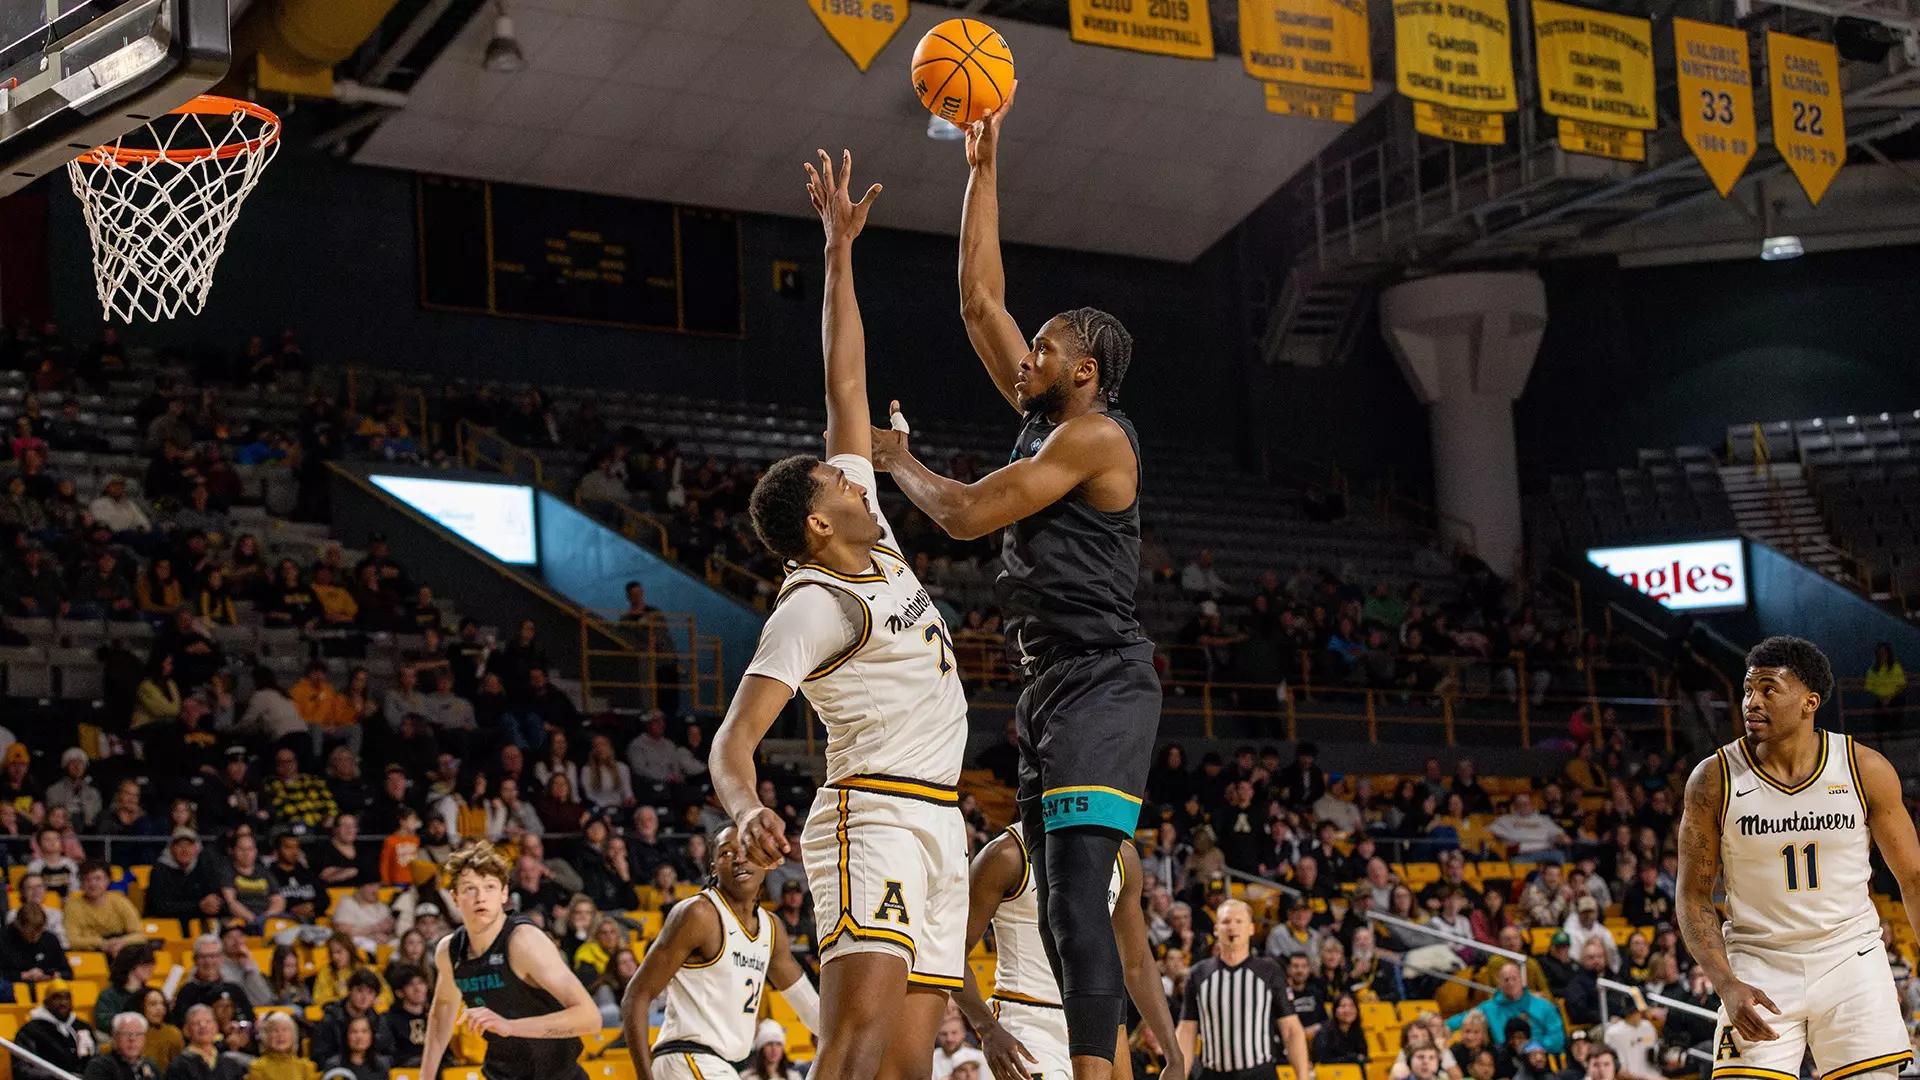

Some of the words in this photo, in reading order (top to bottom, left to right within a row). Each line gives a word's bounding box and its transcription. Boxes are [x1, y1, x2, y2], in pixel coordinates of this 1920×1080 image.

[1147, 0, 1189, 22] 2019
[1701, 89, 1734, 125] 33
[1793, 101, 1824, 136] 22
[1736, 811, 1856, 836] Mountaineers
[1780, 841, 1820, 891] 11
[874, 880, 910, 925] A
[1715, 1024, 1742, 1061] A
